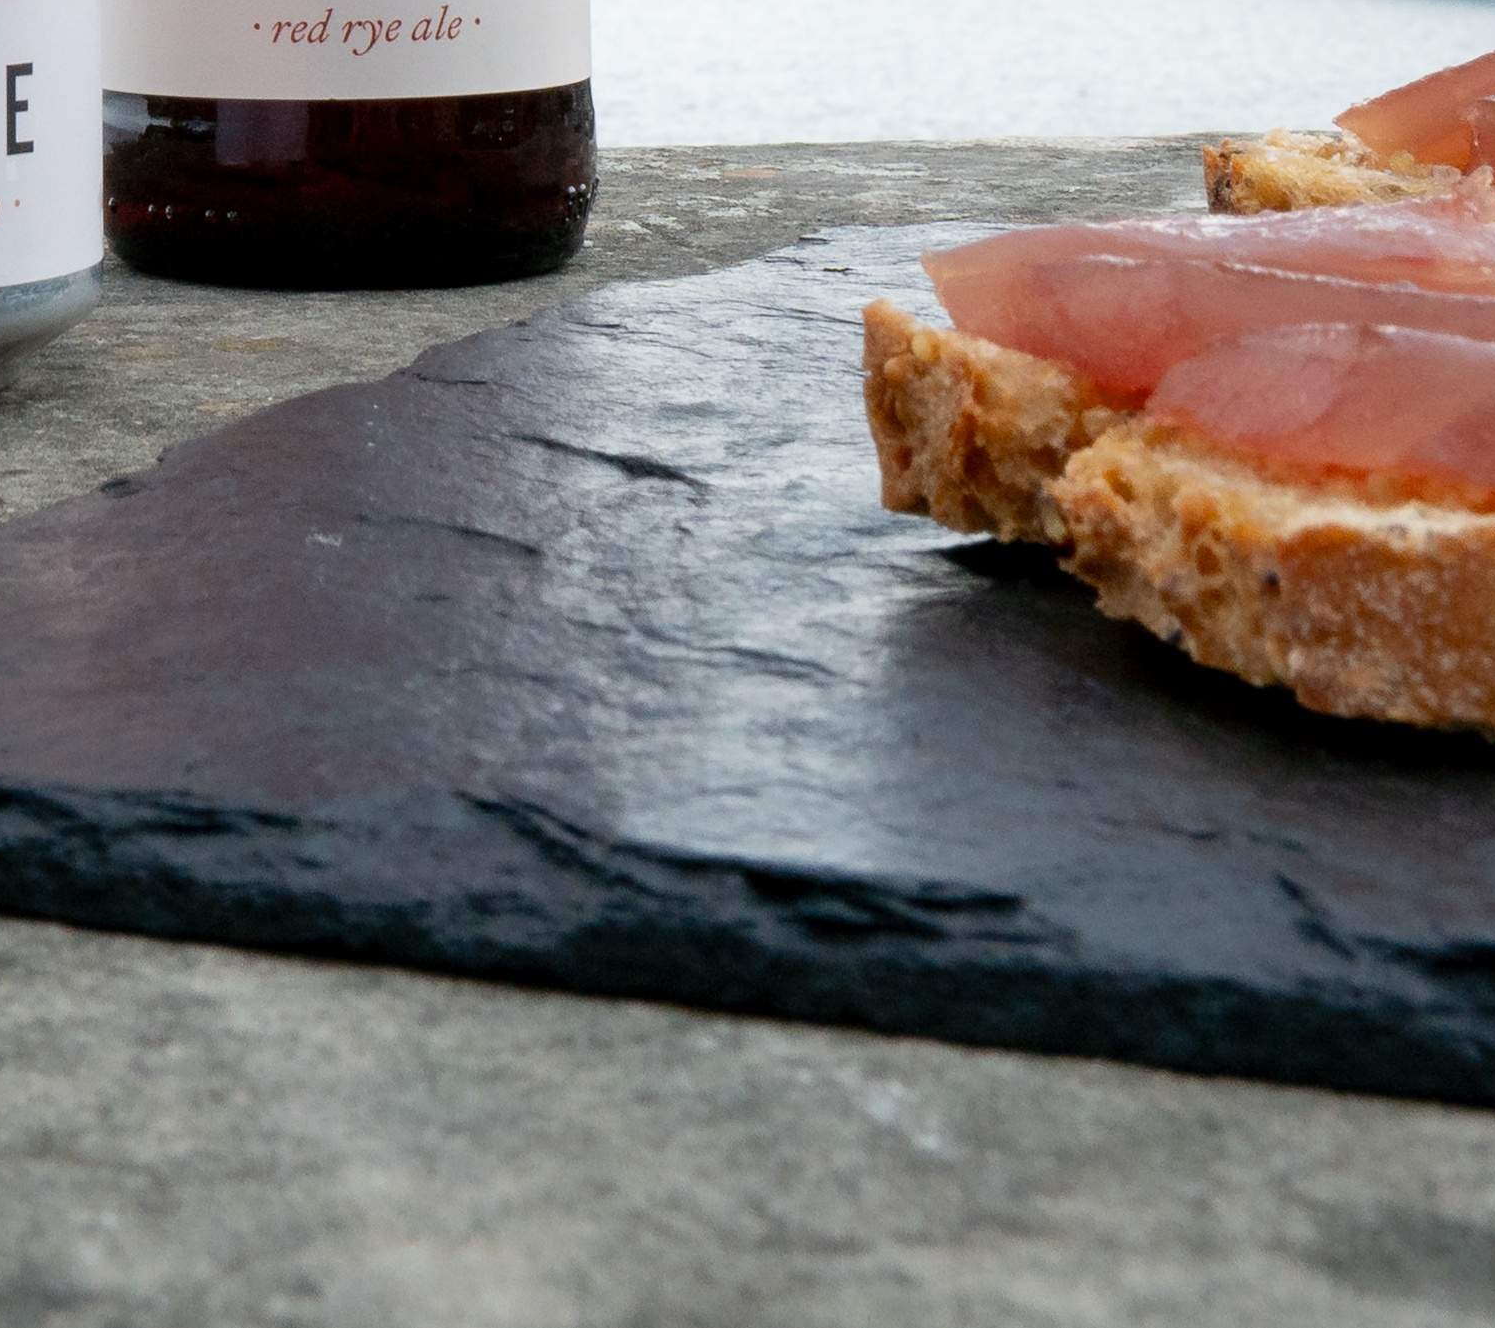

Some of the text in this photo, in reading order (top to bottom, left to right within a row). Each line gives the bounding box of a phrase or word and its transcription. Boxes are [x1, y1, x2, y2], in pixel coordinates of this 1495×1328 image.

[272, 5, 462, 57] red rye ale
